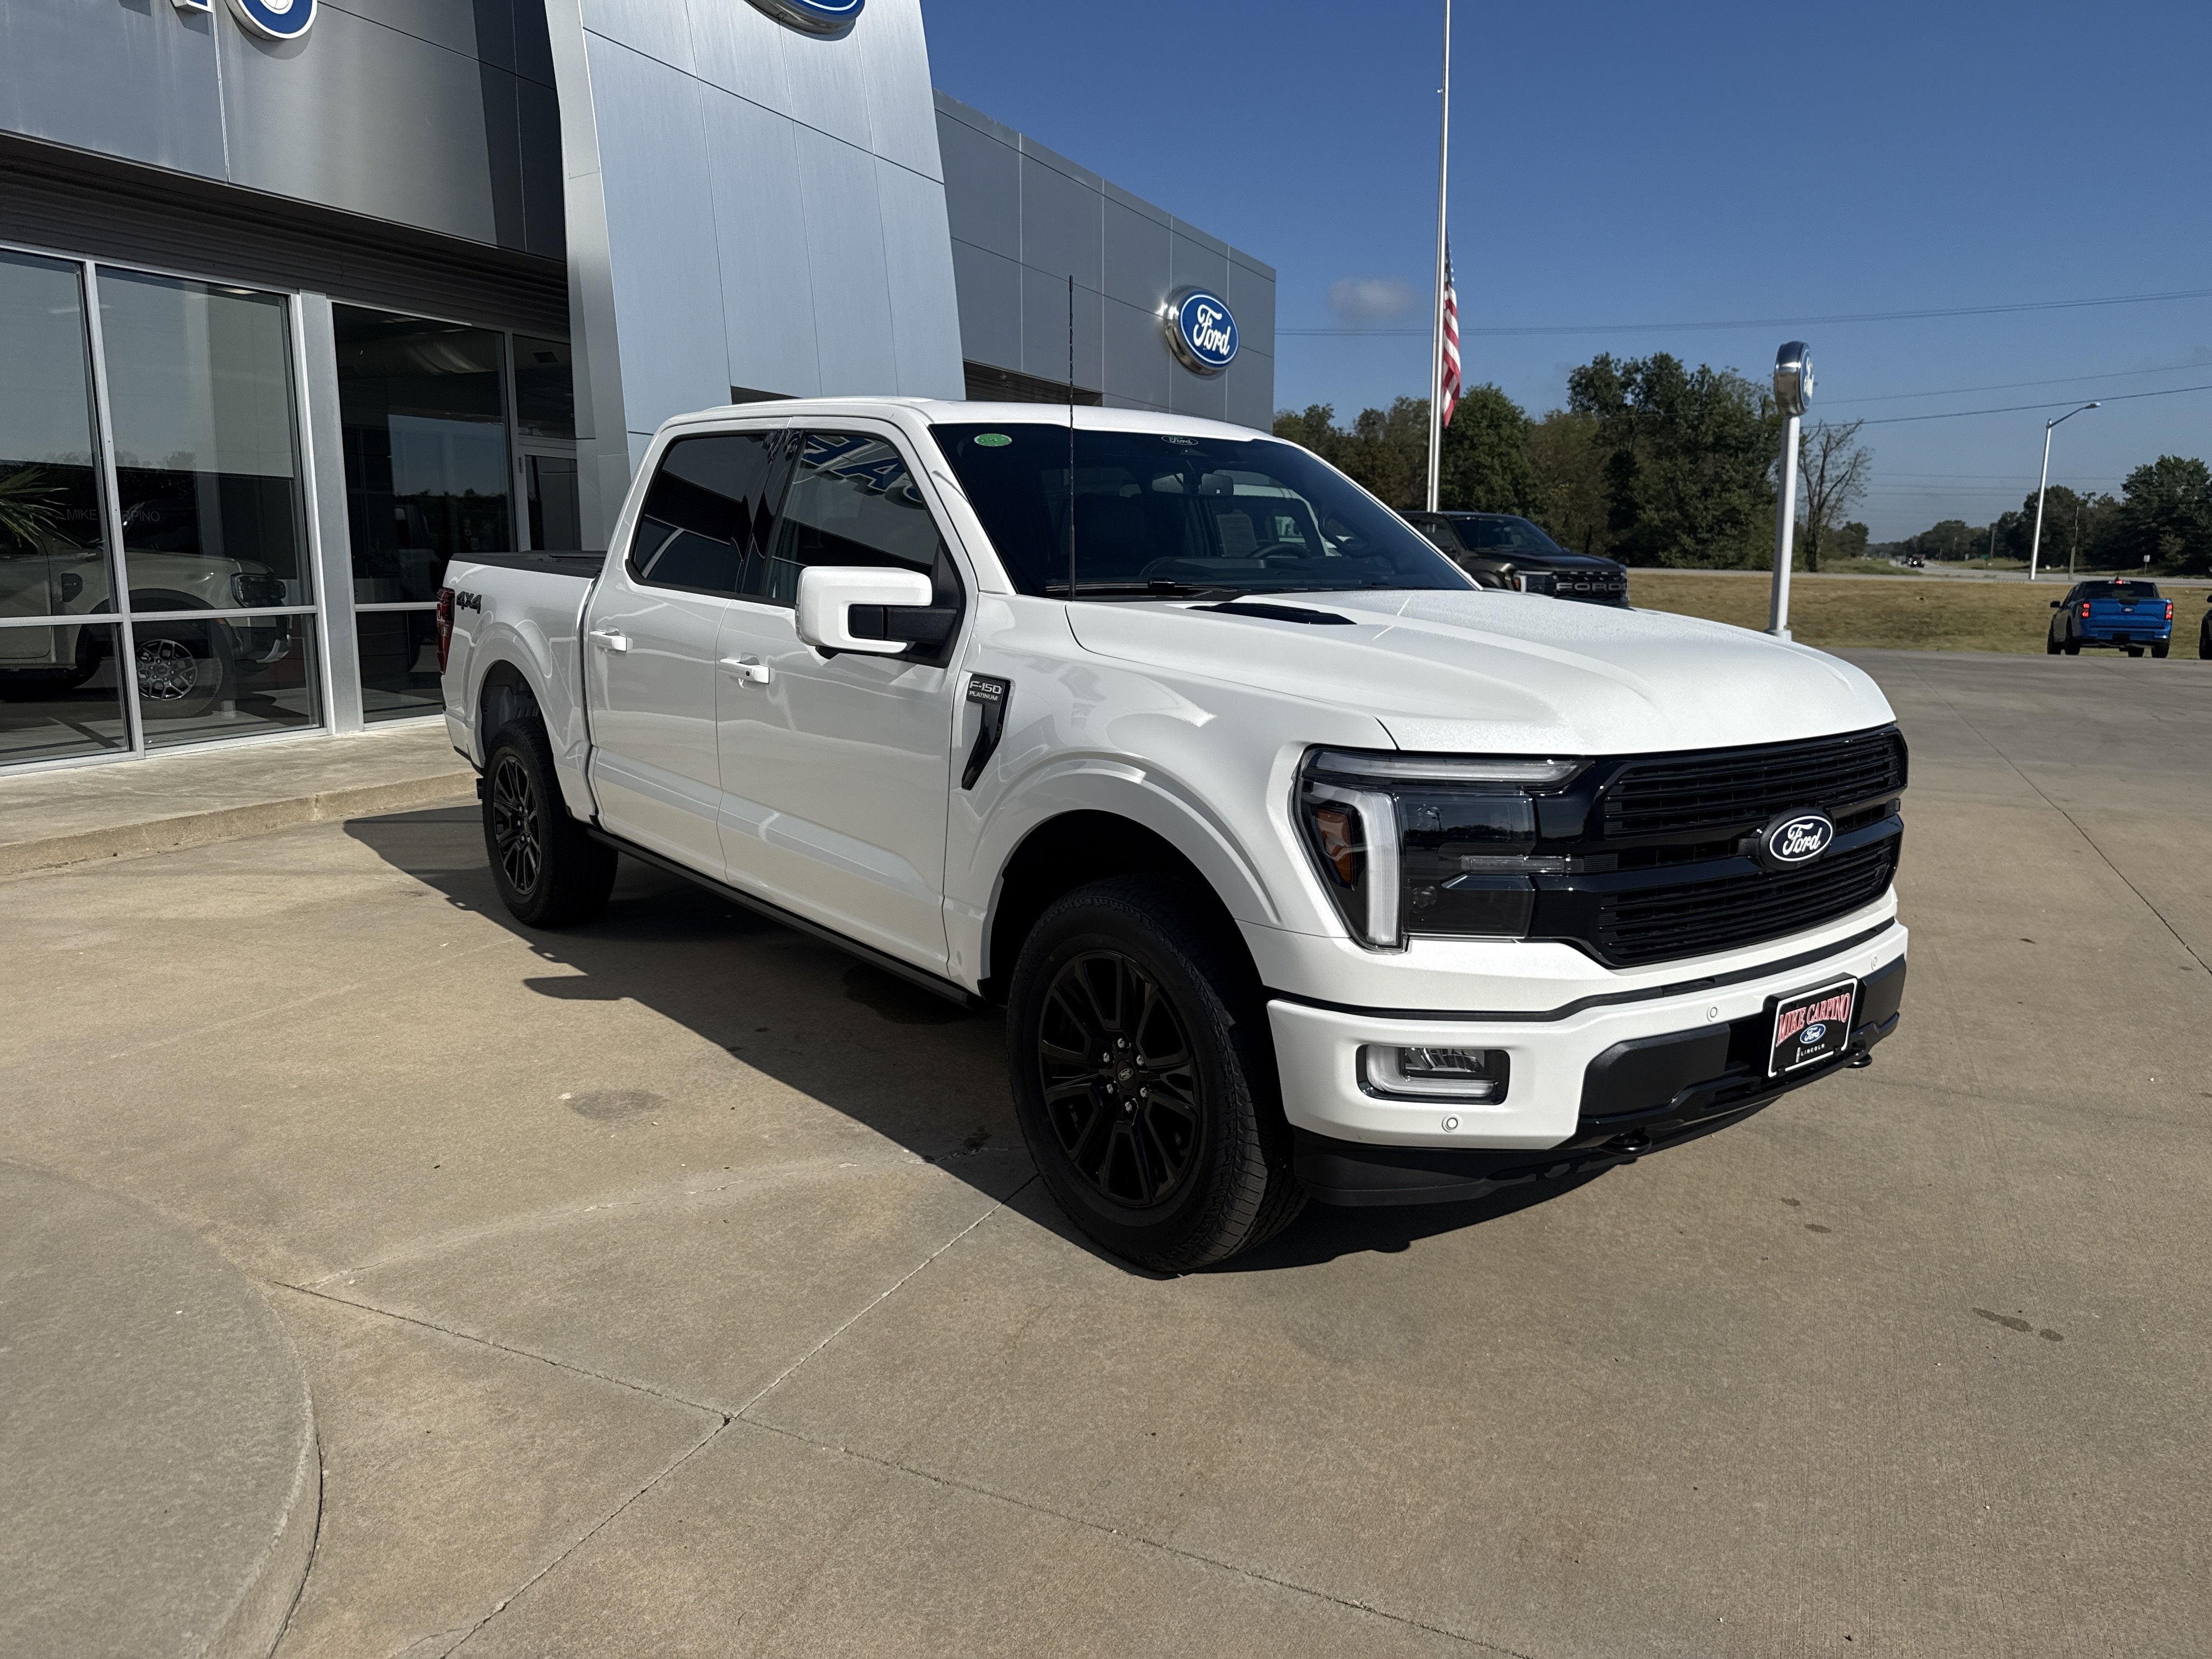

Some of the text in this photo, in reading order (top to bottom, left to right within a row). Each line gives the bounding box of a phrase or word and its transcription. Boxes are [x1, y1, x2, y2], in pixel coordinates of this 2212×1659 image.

[1193, 304, 1231, 356] Ford
[1169, 436, 1193, 444] Ford
[66, 509, 160, 522] MIKE RPINO
[1556, 582, 1622, 592] FORD
[969, 680, 1002, 695] F-150
[969, 690, 998, 701] PLATINUM
[1782, 822, 1822, 855] Ford
[1775, 992, 1850, 1048] MIKE CARPINO
[1804, 1026, 1821, 1041] Ford
[1801, 1043, 1825, 1057] LINCOLN
